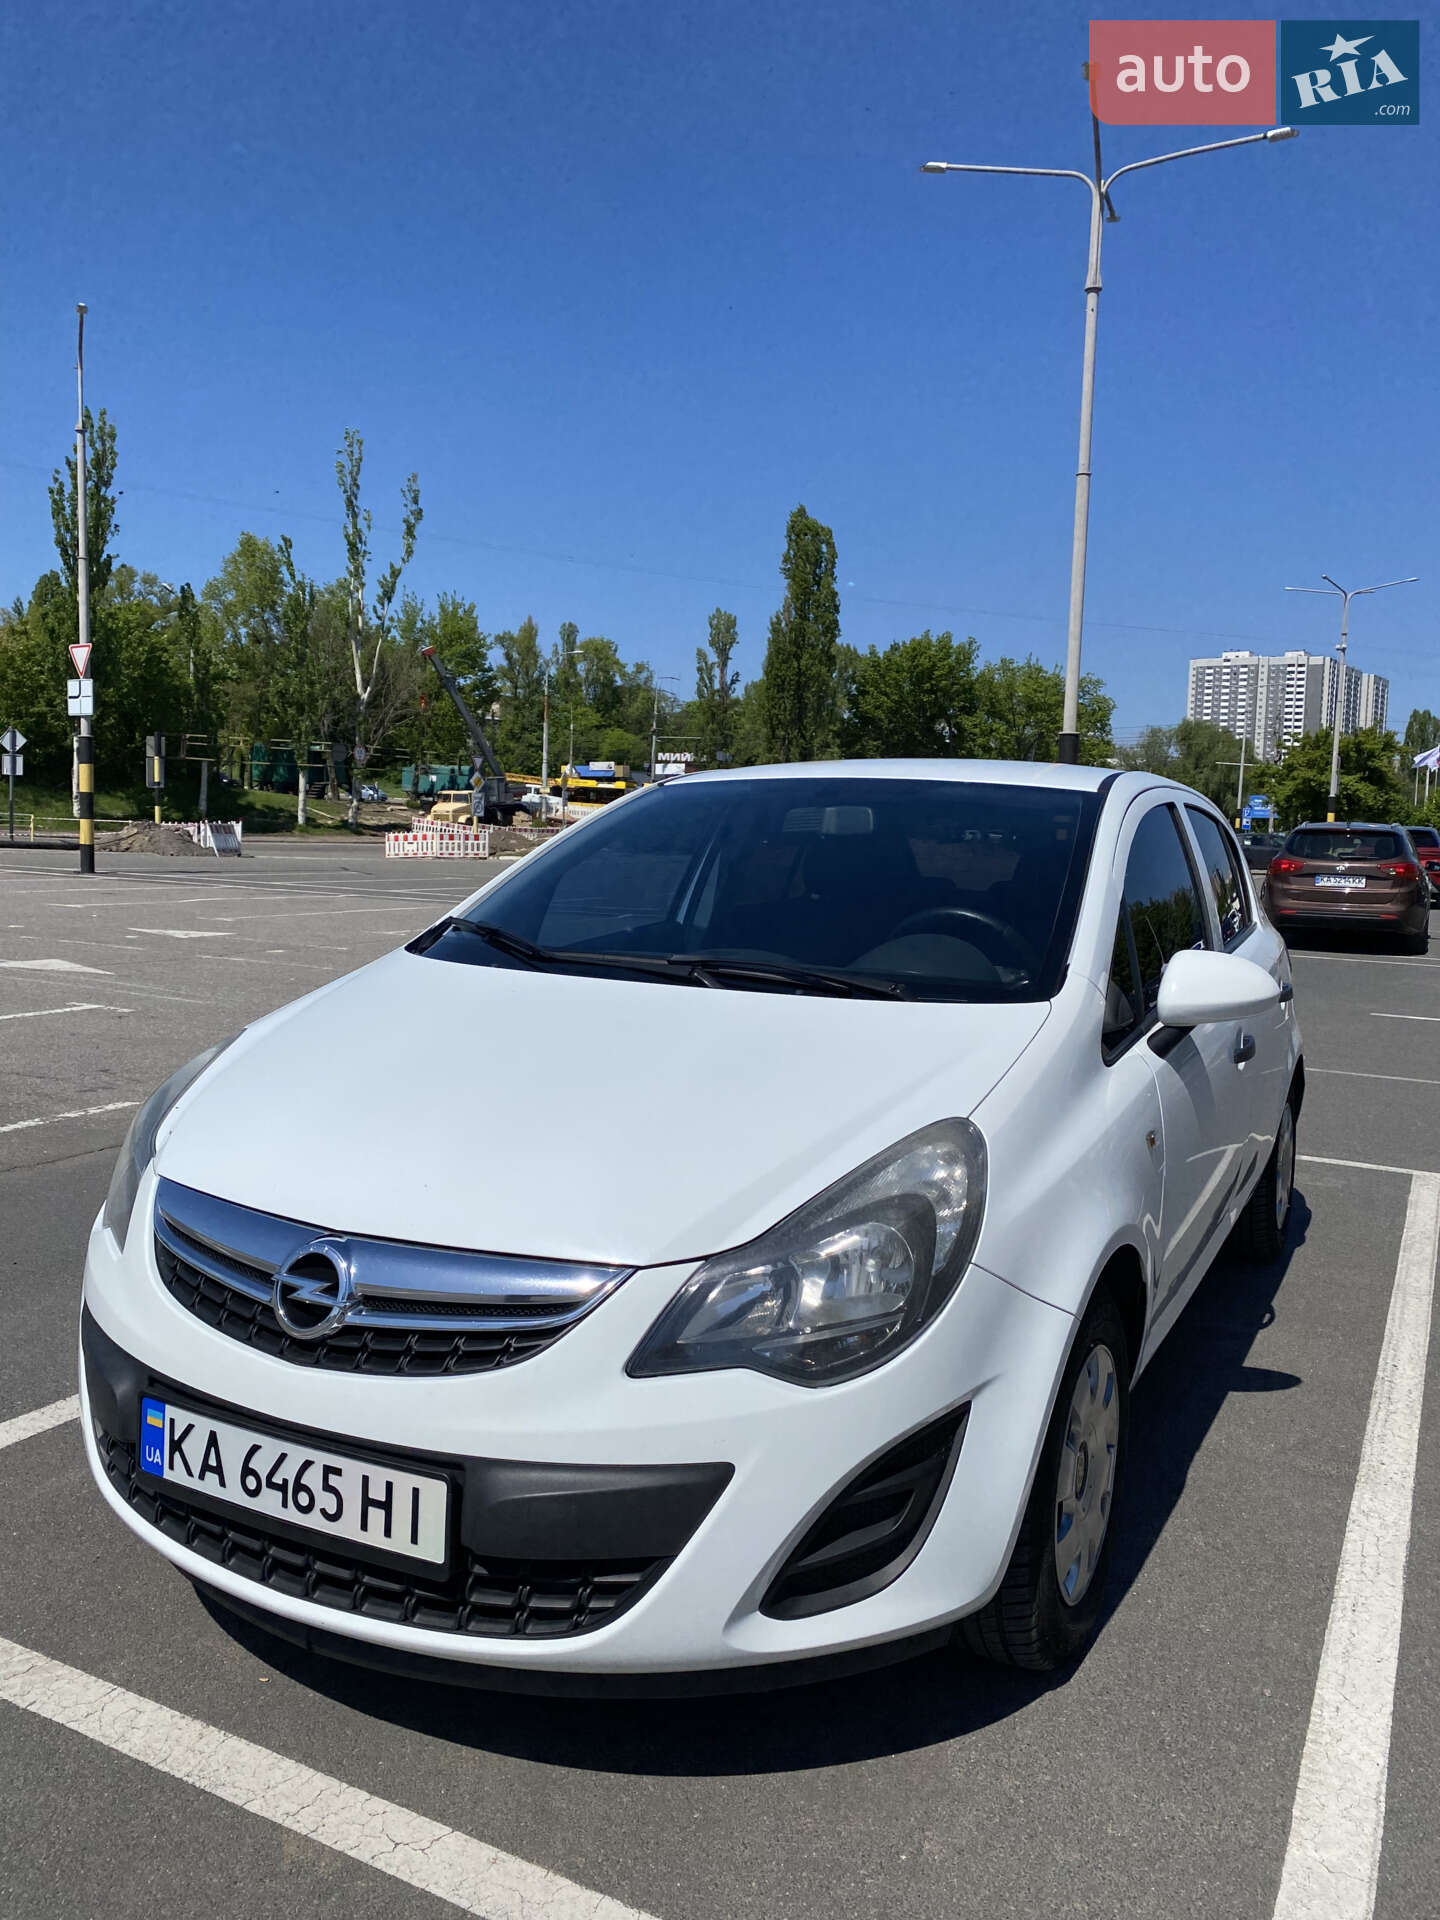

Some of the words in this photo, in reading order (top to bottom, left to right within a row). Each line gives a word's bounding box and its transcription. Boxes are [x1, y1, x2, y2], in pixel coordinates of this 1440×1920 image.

[145, 1444, 162, 1467] UA
[168, 1417, 227, 1489] KA
[239, 1443, 344, 1523] 6465
[360, 1474, 420, 1546] HI
